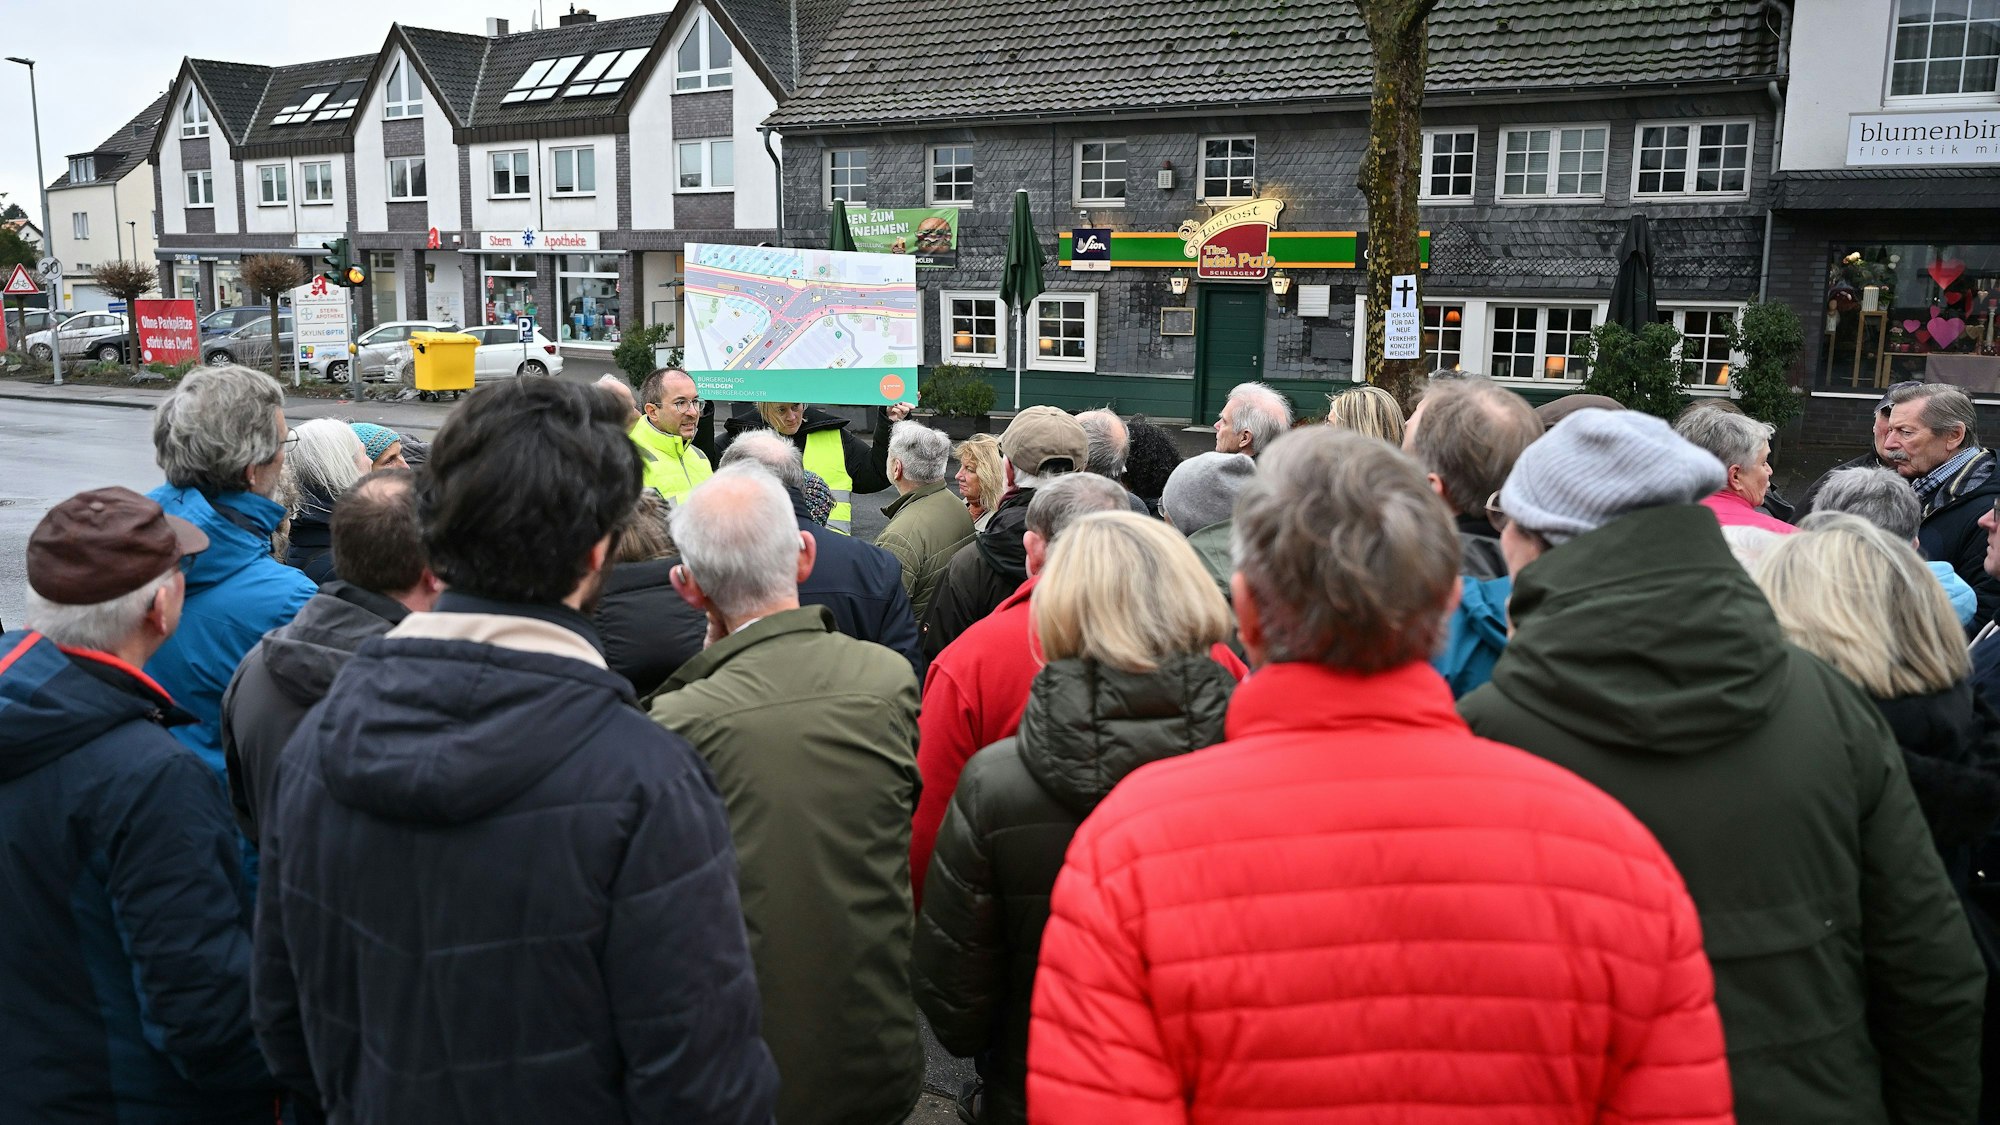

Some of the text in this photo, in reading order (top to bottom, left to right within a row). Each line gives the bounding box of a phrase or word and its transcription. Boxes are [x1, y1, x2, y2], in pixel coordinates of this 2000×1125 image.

[1859, 144, 1959, 156] floristik
[870, 210, 895, 223] ZUM
[489, 233, 587, 250] Stern Apotheke
[1203, 244, 1228, 256] The
[1202, 251, 1276, 268] Irish Pub
[41, 261, 58, 275] 30
[141, 315, 193, 332] Ohne Parkplätze
[1391, 318, 1403, 326] FÜR
[519, 318, 531, 341] P
[146, 335, 193, 350] stirbt das Dorf!
